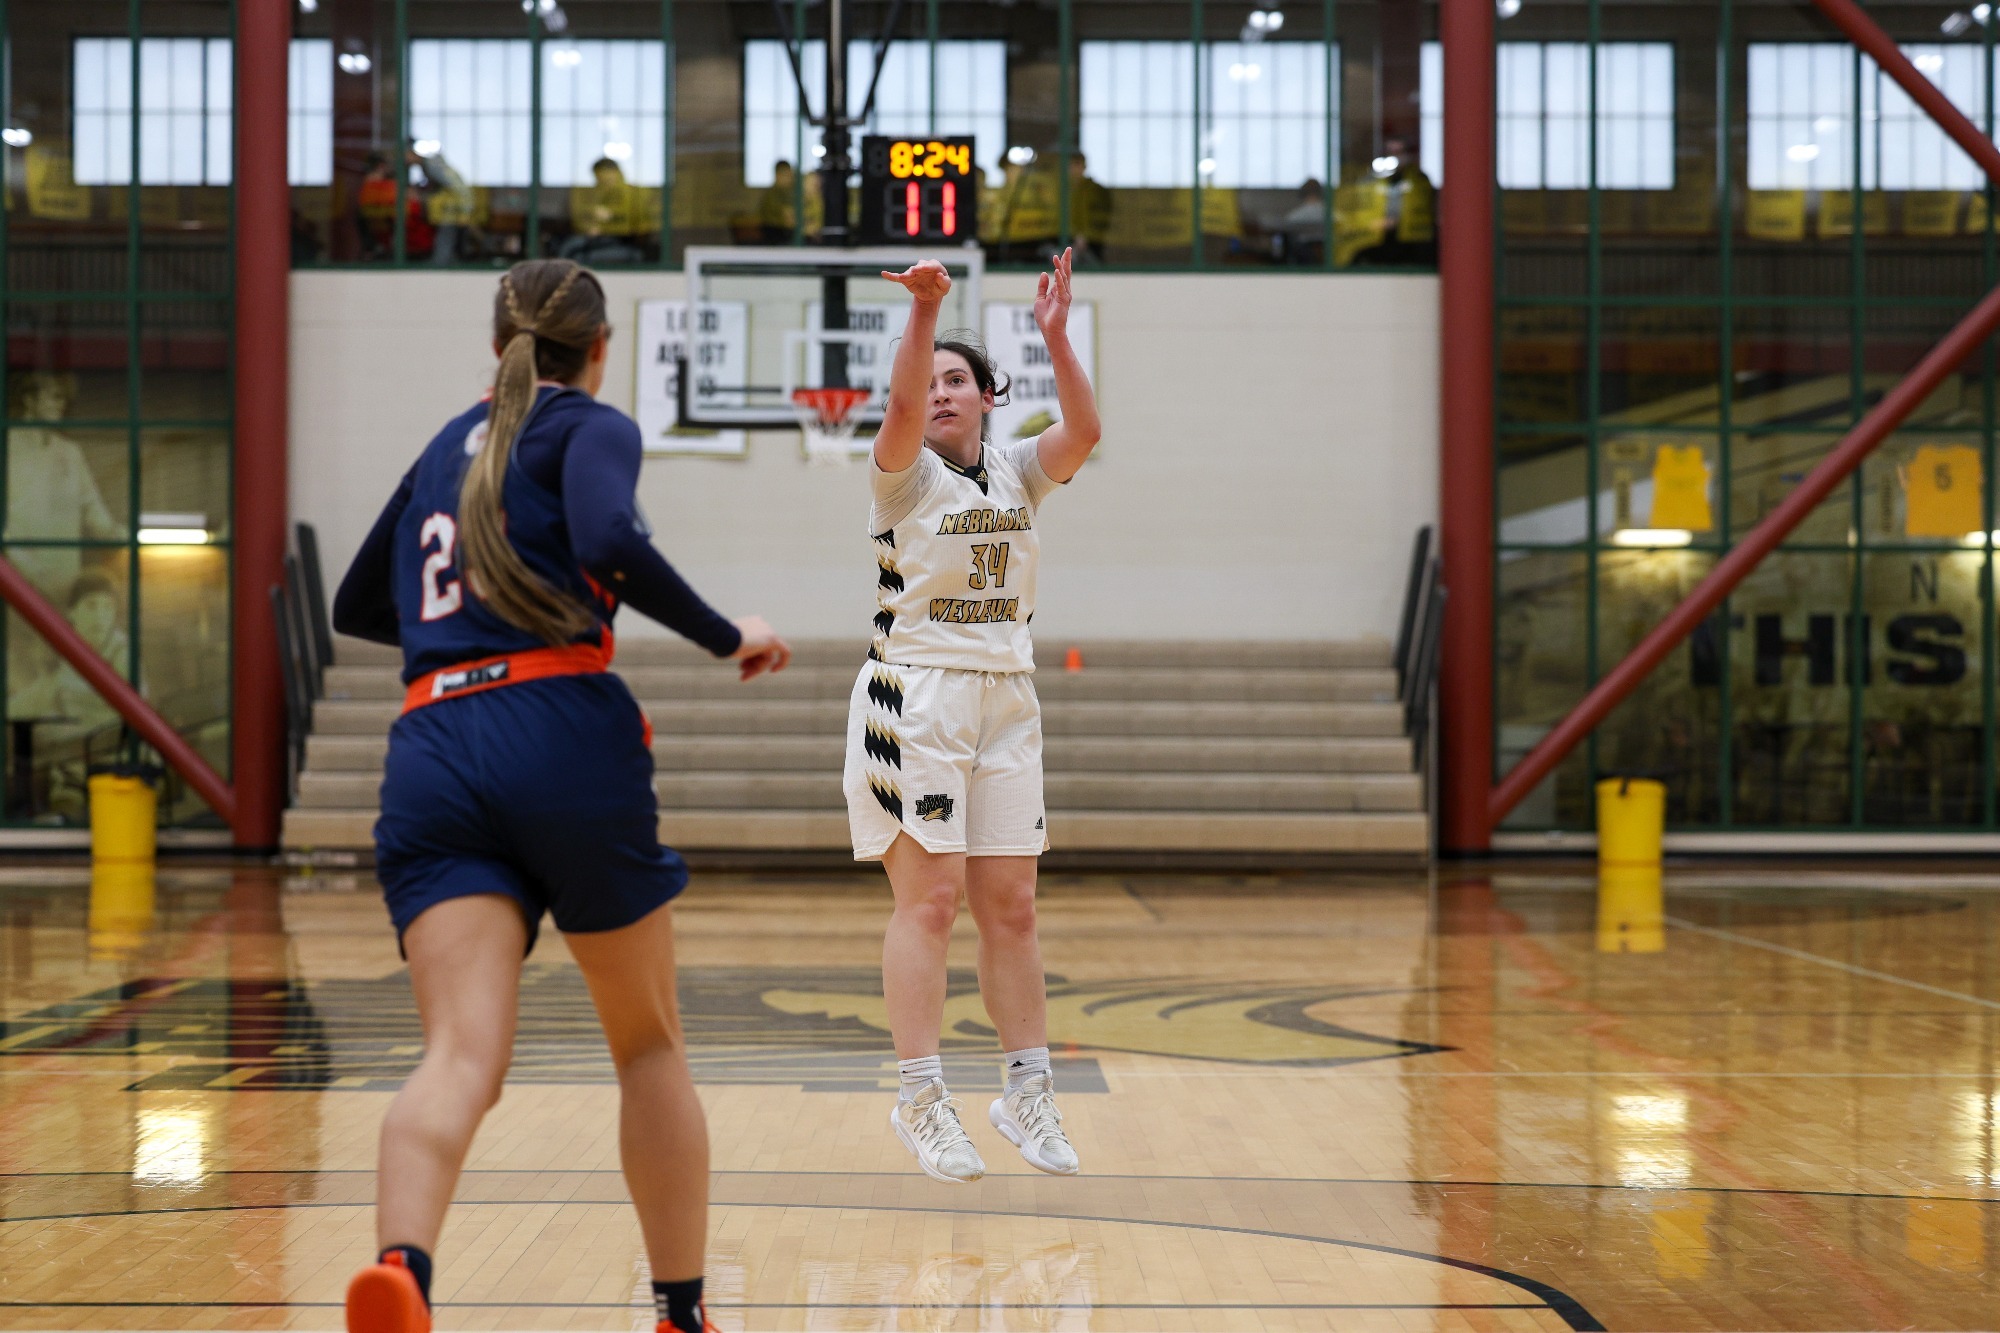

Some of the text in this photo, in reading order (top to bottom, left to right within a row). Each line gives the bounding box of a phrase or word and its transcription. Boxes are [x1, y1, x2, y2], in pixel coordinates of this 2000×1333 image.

[890, 142, 969, 178] 8:24
[907, 182, 955, 235] 11
[968, 542, 1009, 590] 34
[930, 596, 1018, 623] WESLEYA
